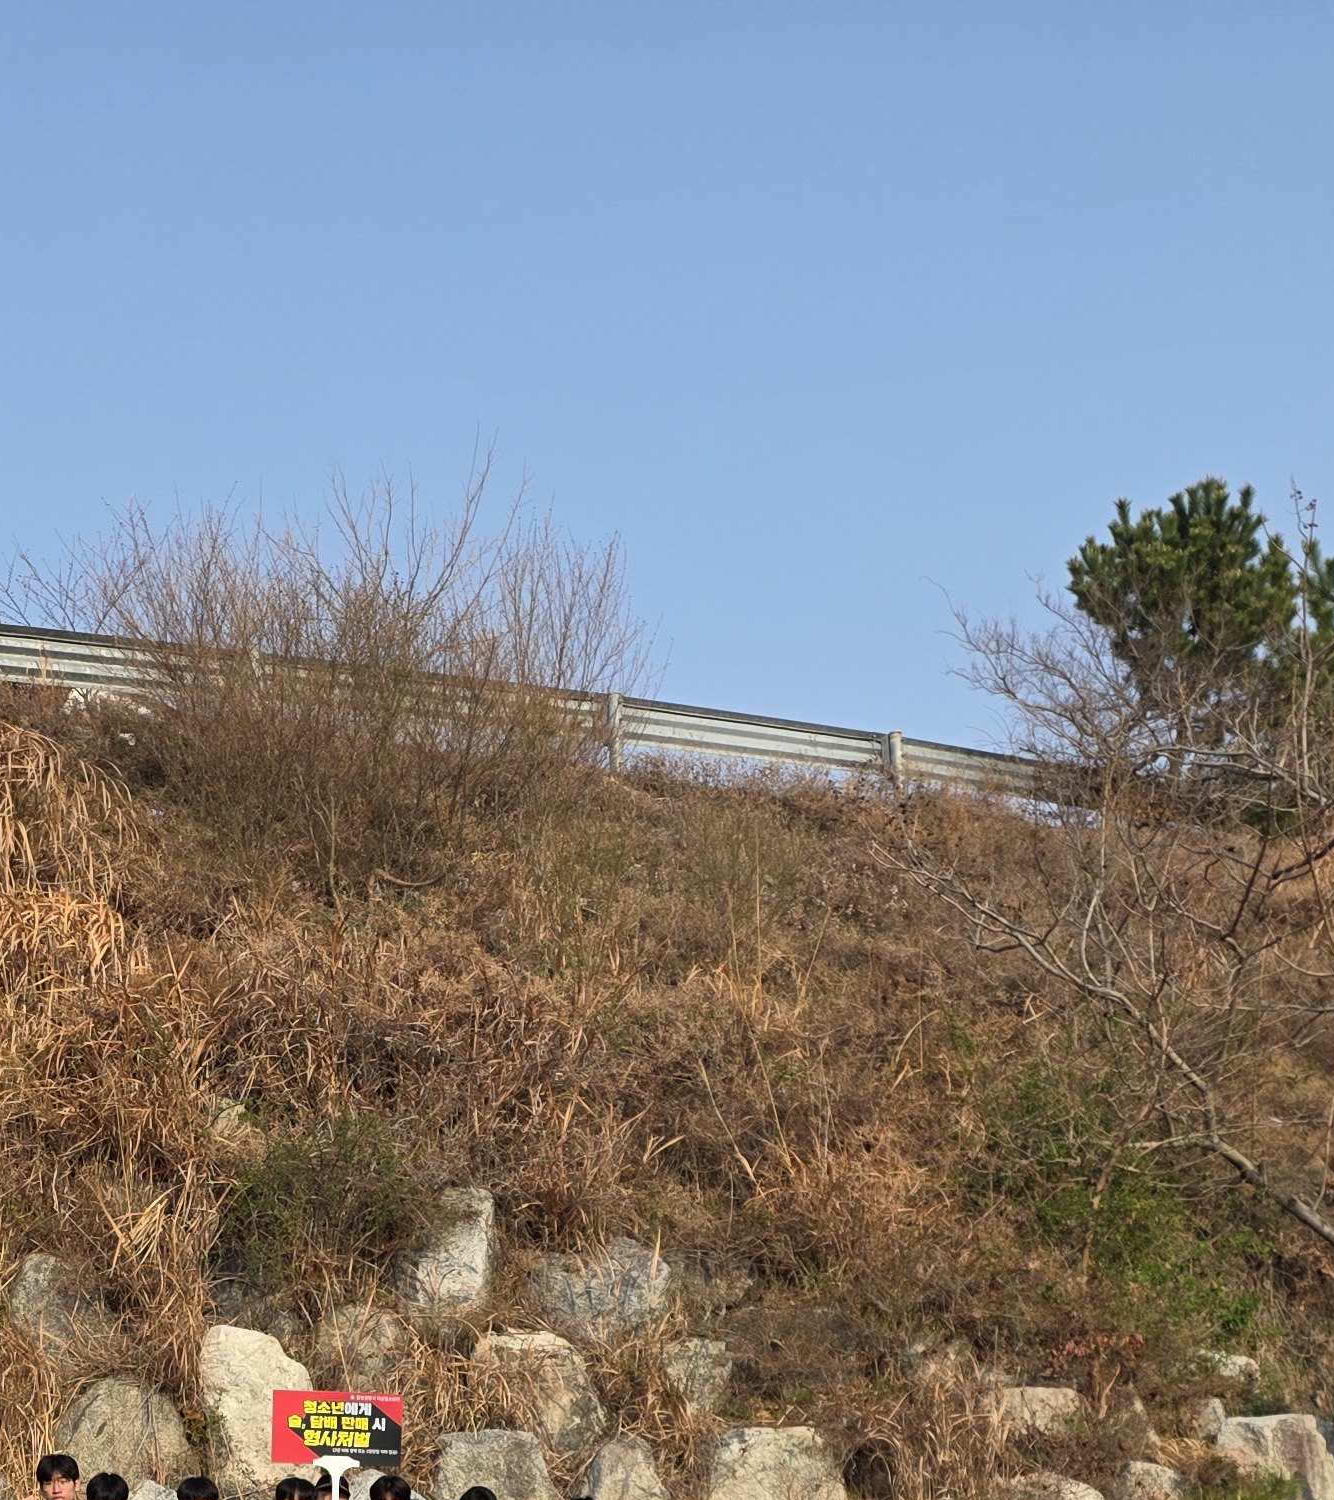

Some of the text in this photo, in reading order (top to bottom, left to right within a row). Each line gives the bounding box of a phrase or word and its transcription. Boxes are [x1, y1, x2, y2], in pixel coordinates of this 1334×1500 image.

[303, 1400, 373, 1416] 청소년에게
[288, 1414, 386, 1432] 술, 담배 판매 시
[303, 1429, 371, 1448] 형사처벌
